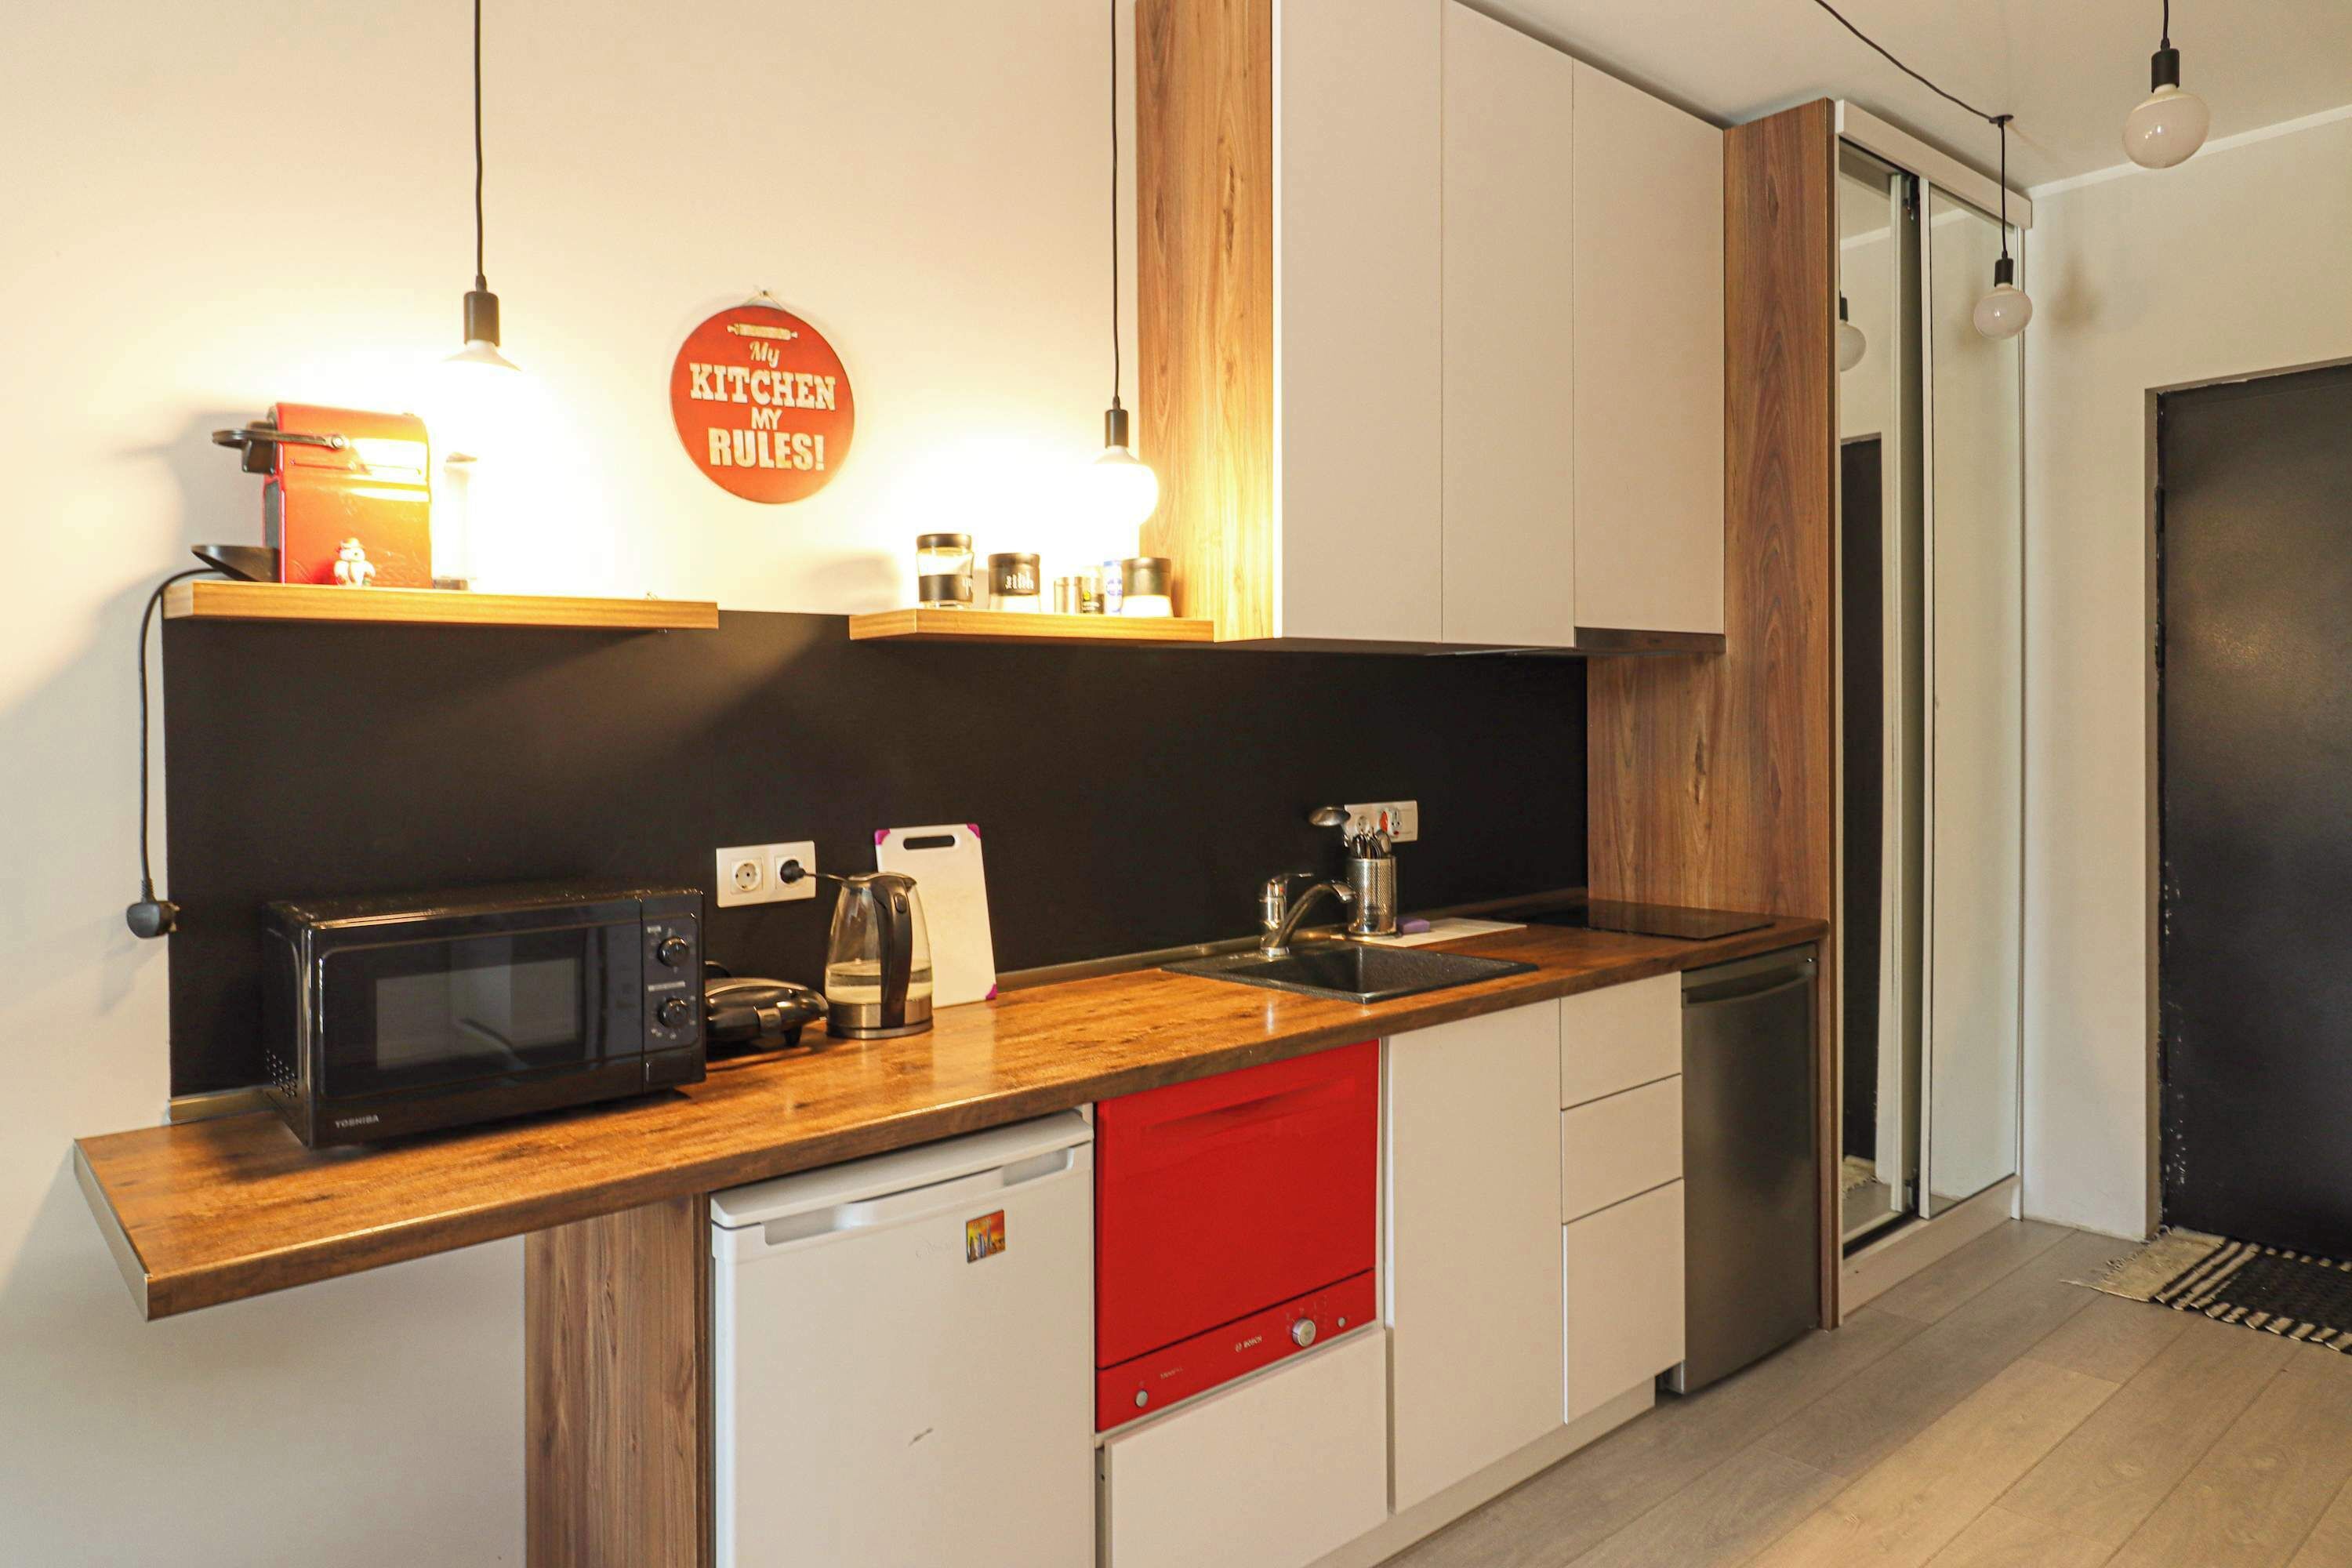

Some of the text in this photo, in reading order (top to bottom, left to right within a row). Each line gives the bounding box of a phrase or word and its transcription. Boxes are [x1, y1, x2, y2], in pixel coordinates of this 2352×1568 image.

[750, 341, 779, 368] My
[689, 362, 836, 411] KITCHEN
[751, 407, 782, 430] MY
[708, 427, 825, 470] RULES!
[335, 1114, 379, 1128] TOSHIBA
[1243, 1335, 1262, 1348] BOSCH
